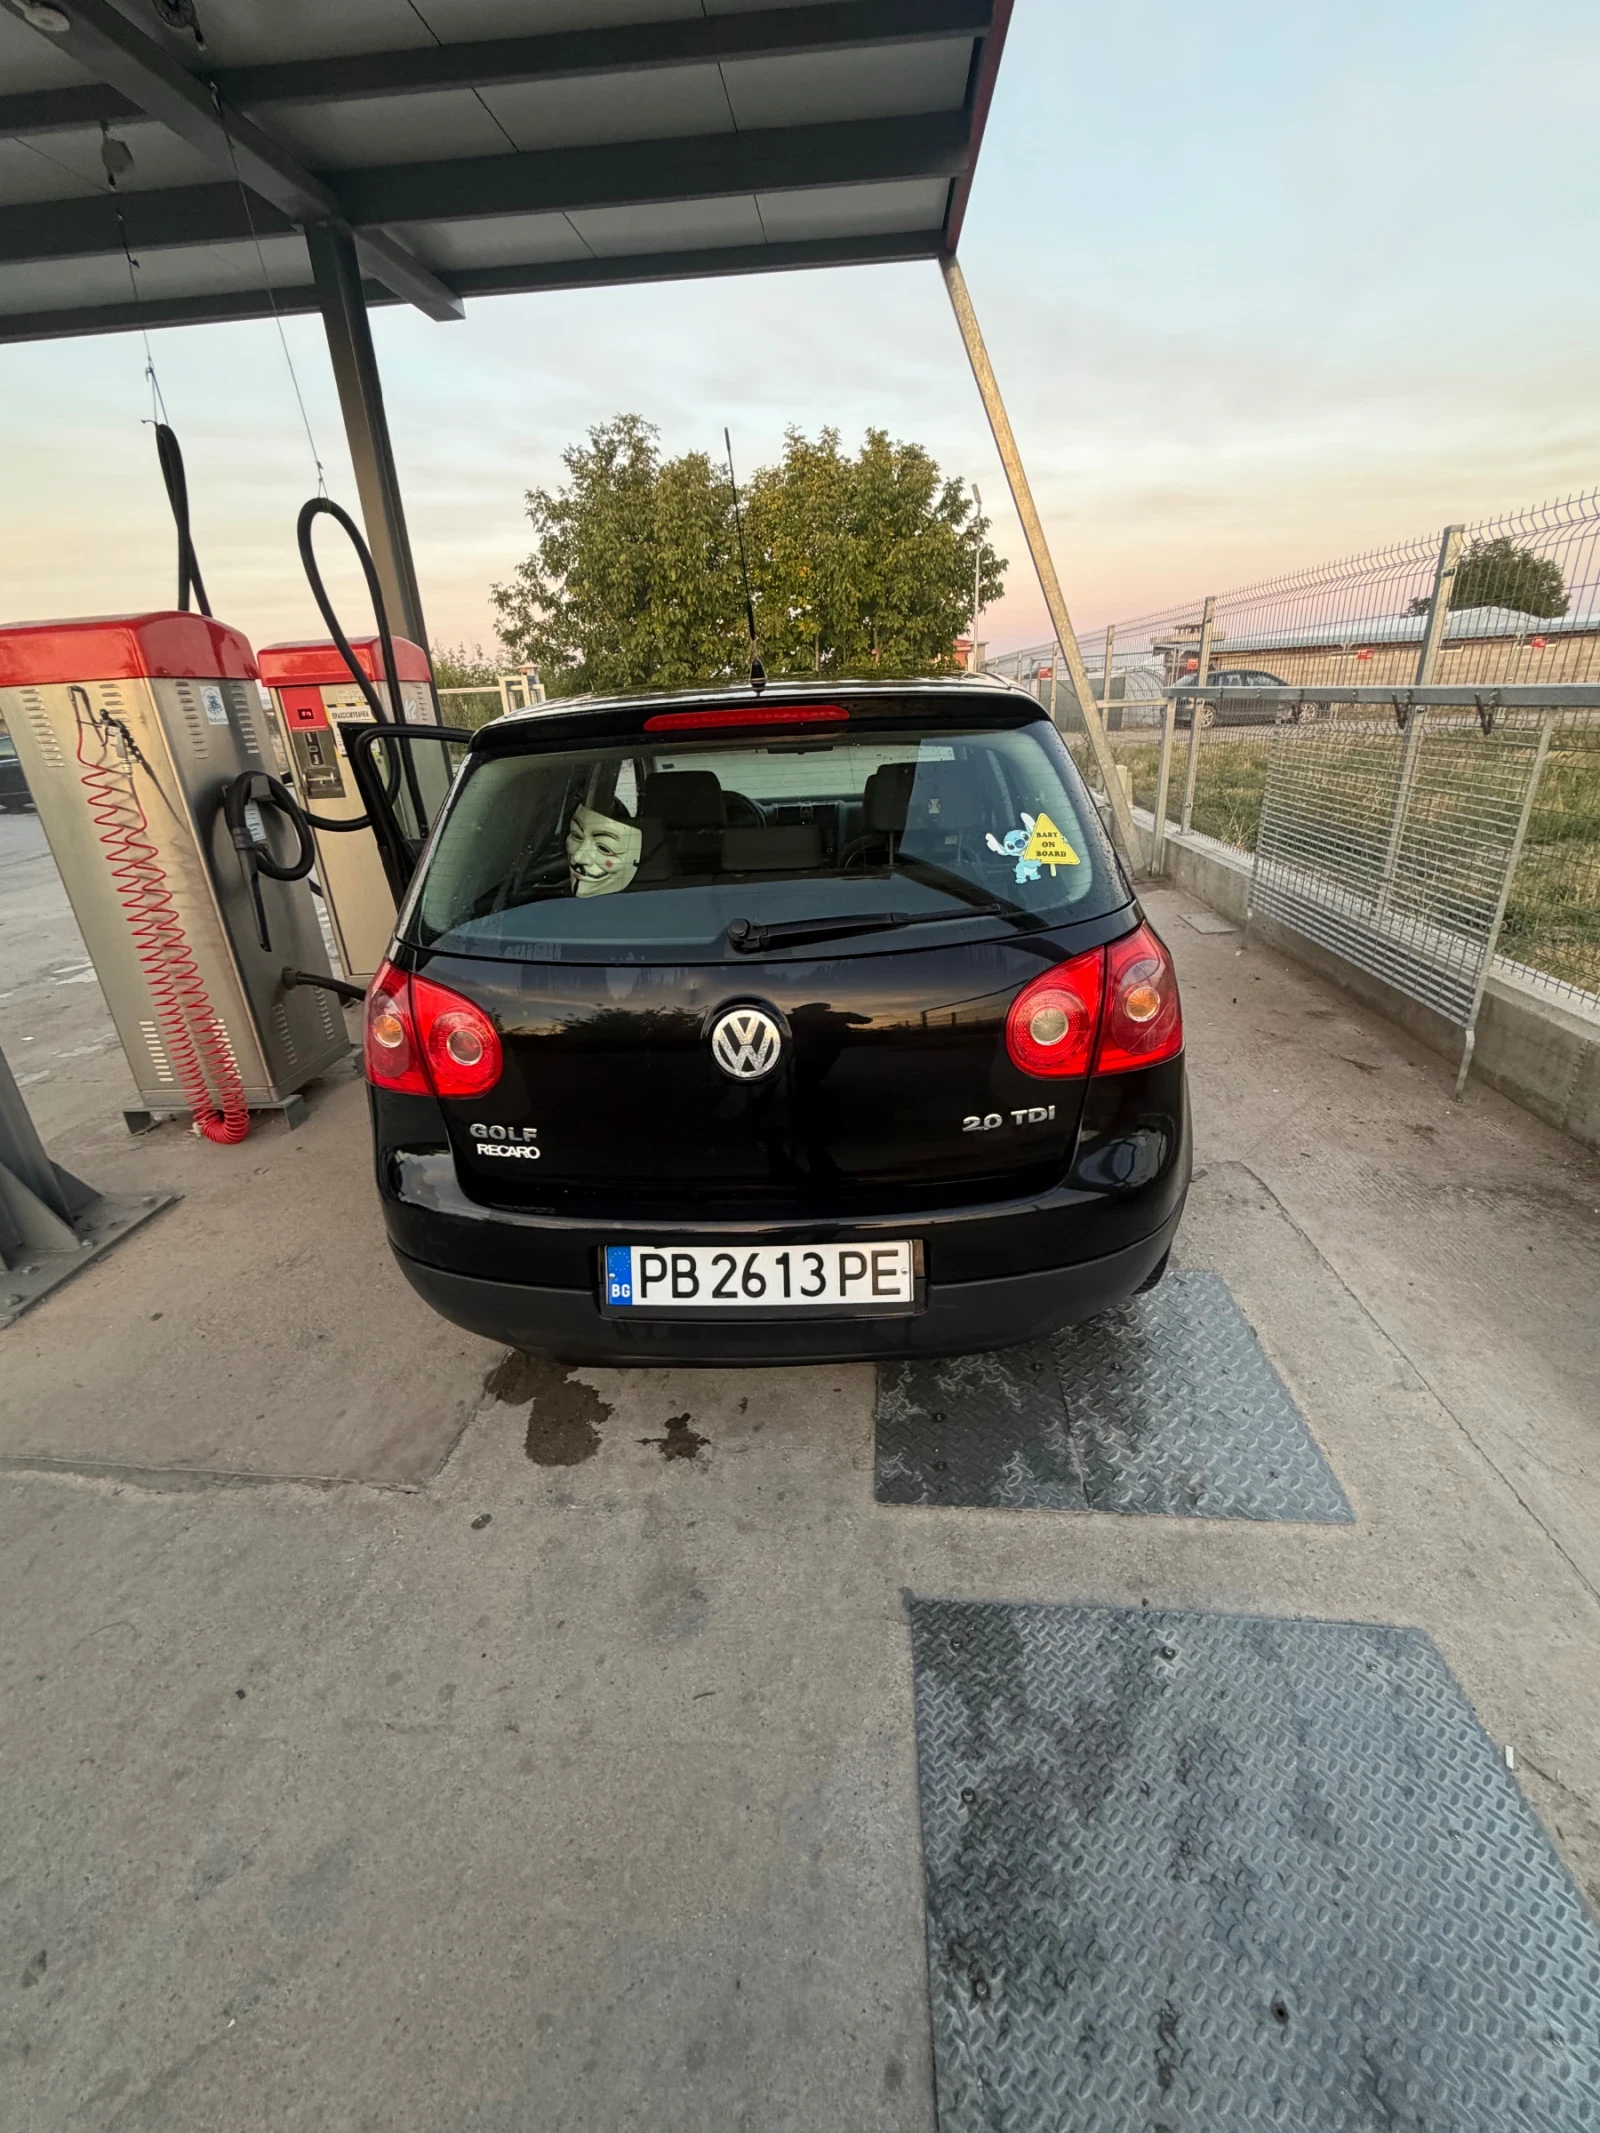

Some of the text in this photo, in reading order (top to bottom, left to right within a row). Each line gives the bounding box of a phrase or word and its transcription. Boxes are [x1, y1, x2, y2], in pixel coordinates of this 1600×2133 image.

[1036, 850, 1067, 858] BOARD
[1010, 1104, 1056, 1126] TDI
[469, 1123, 538, 1143] GOLF
[476, 1143, 541, 1160] RECARO
[611, 1283, 631, 1298] BG
